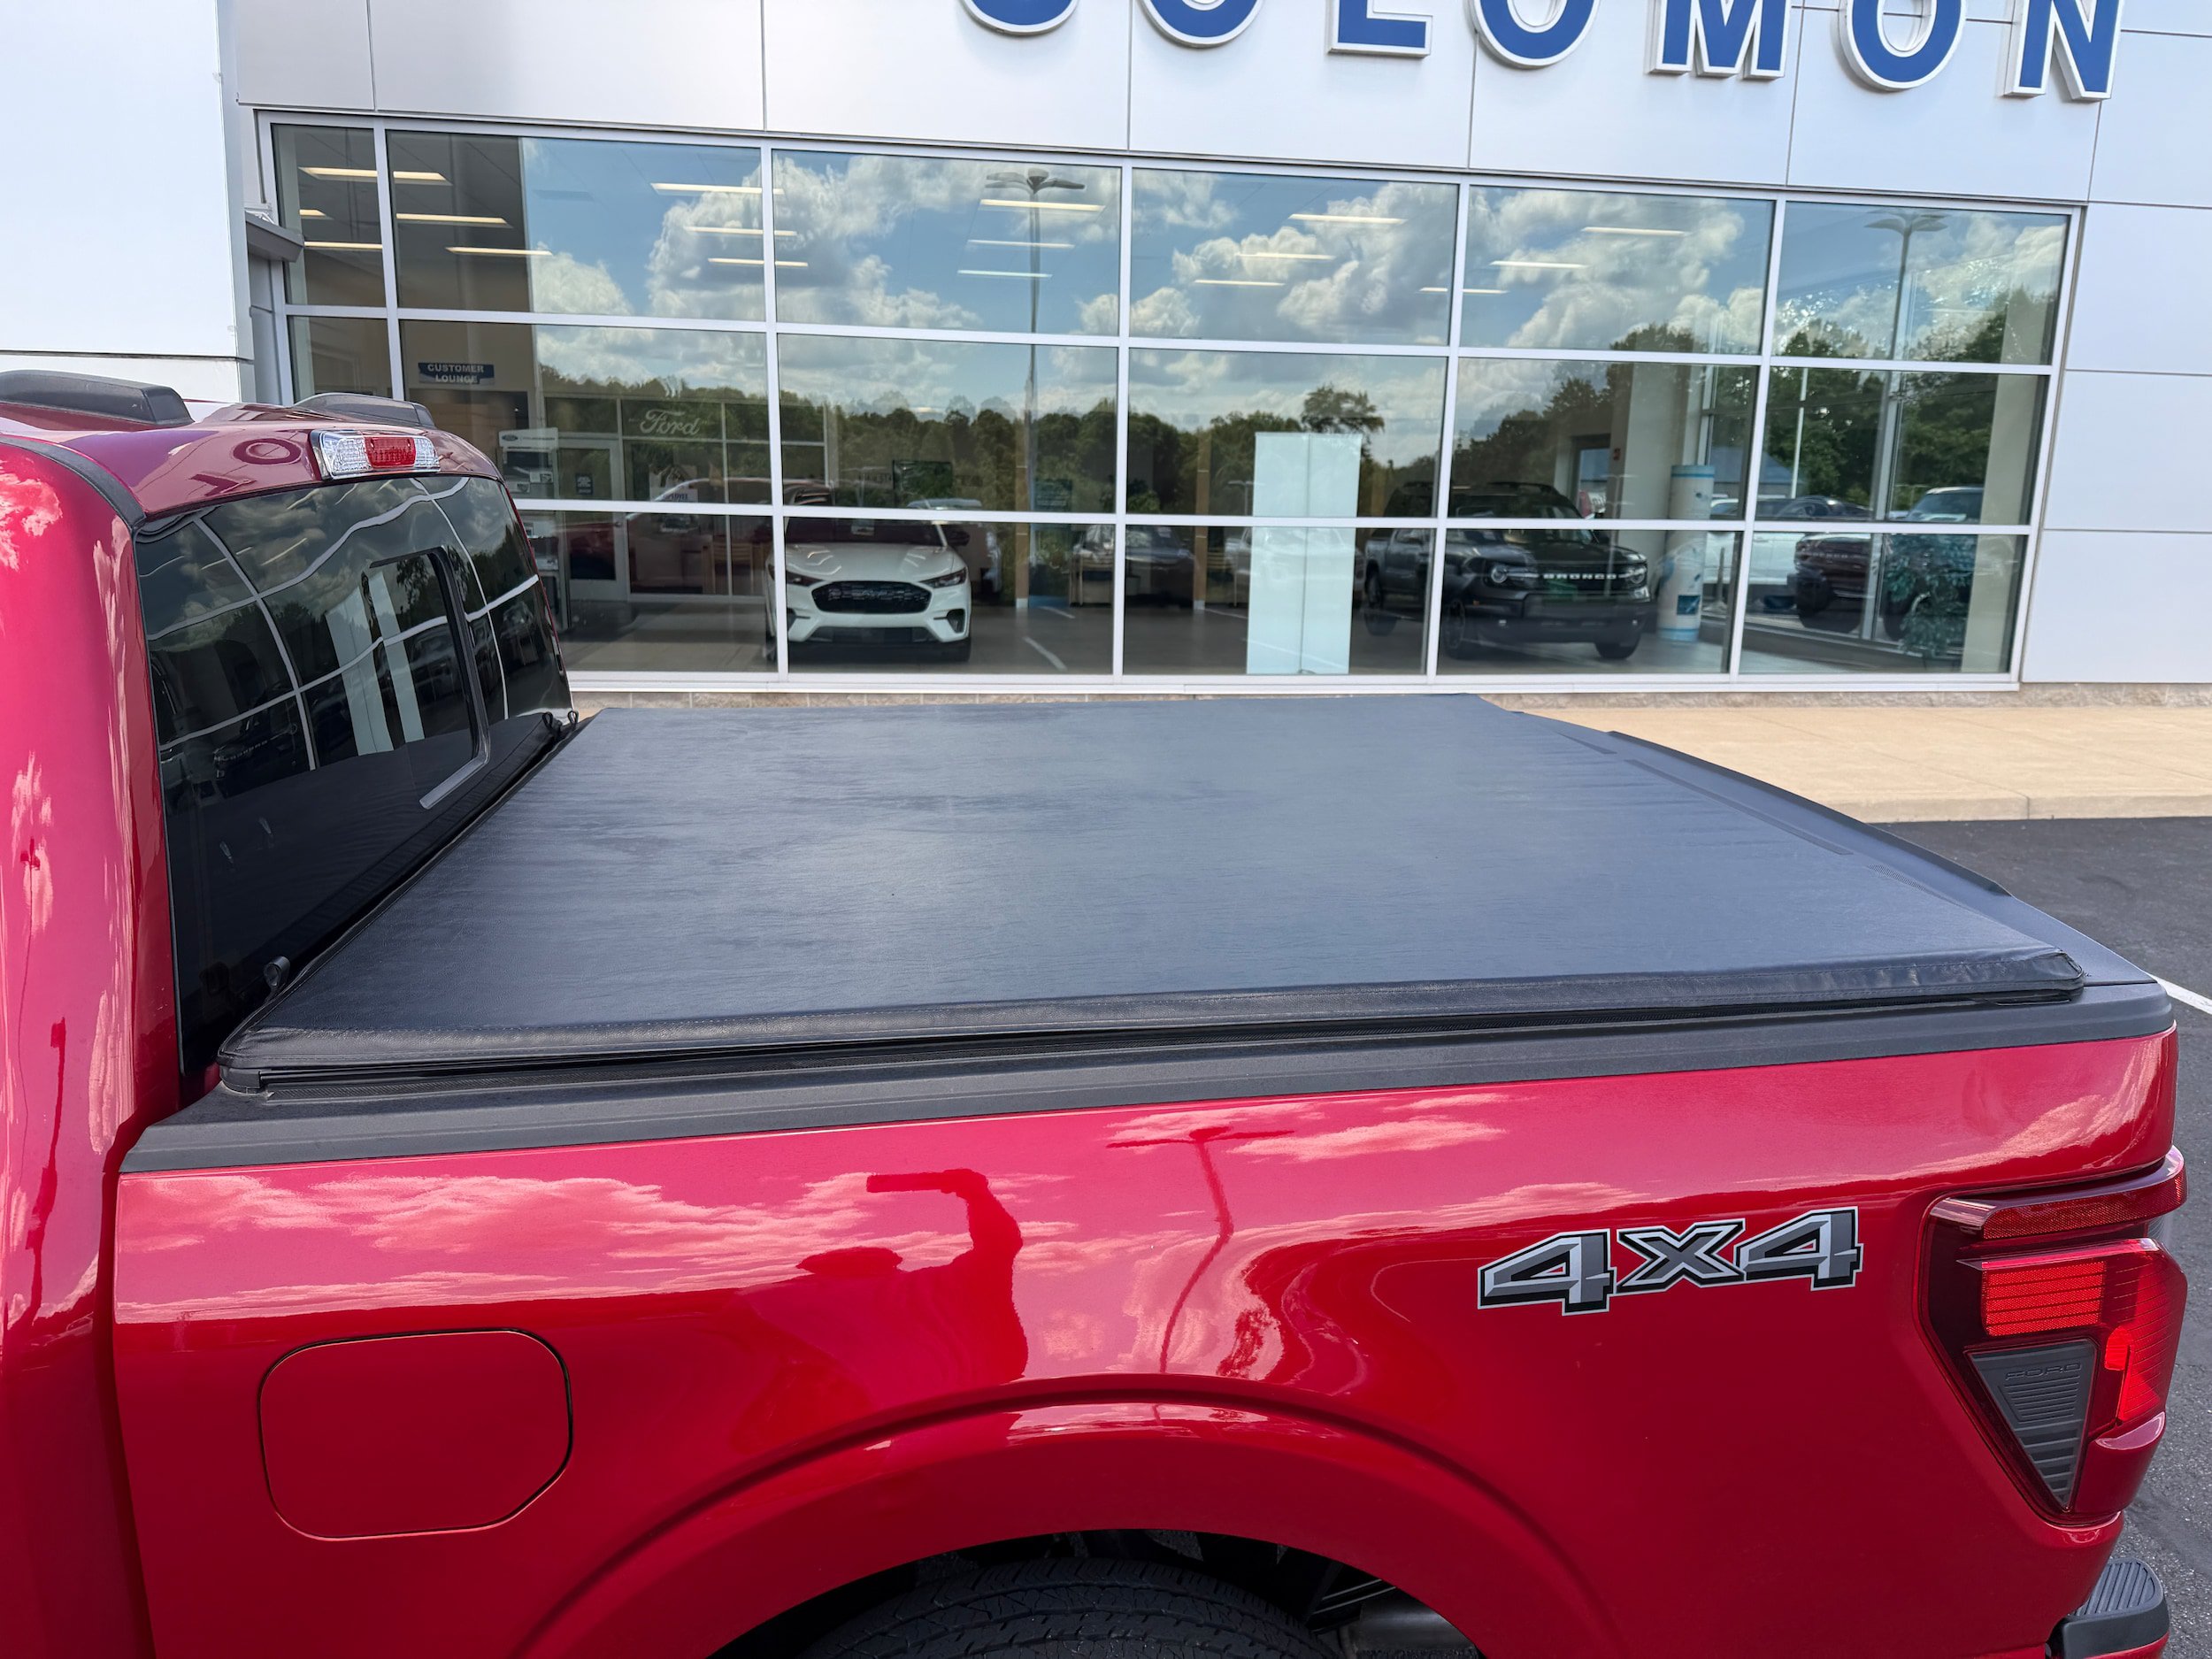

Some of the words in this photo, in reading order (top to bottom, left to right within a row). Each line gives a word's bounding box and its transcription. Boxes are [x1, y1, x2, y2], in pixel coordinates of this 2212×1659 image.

[427, 364, 484, 373] CUSTOMER
[435, 374, 478, 383] LOUNGE
[640, 409, 702, 435] Ford
[2005, 1363, 2082, 1381] FORD
